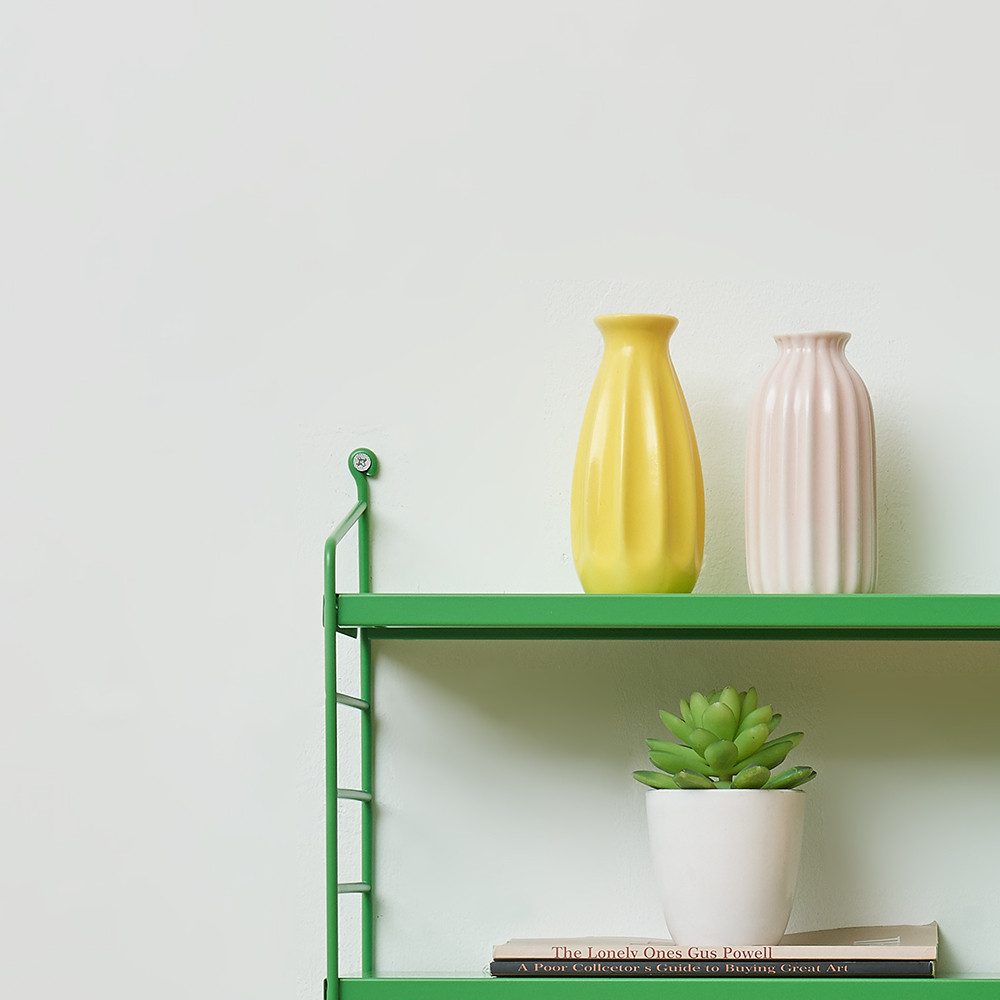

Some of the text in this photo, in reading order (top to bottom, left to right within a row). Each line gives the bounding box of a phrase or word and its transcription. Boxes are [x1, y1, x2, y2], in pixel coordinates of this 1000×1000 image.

[551, 946, 773, 959] The Lonely Ones Gus Powell
[517, 963, 849, 974] A Poor Collectors Guide to Buying Great Art
